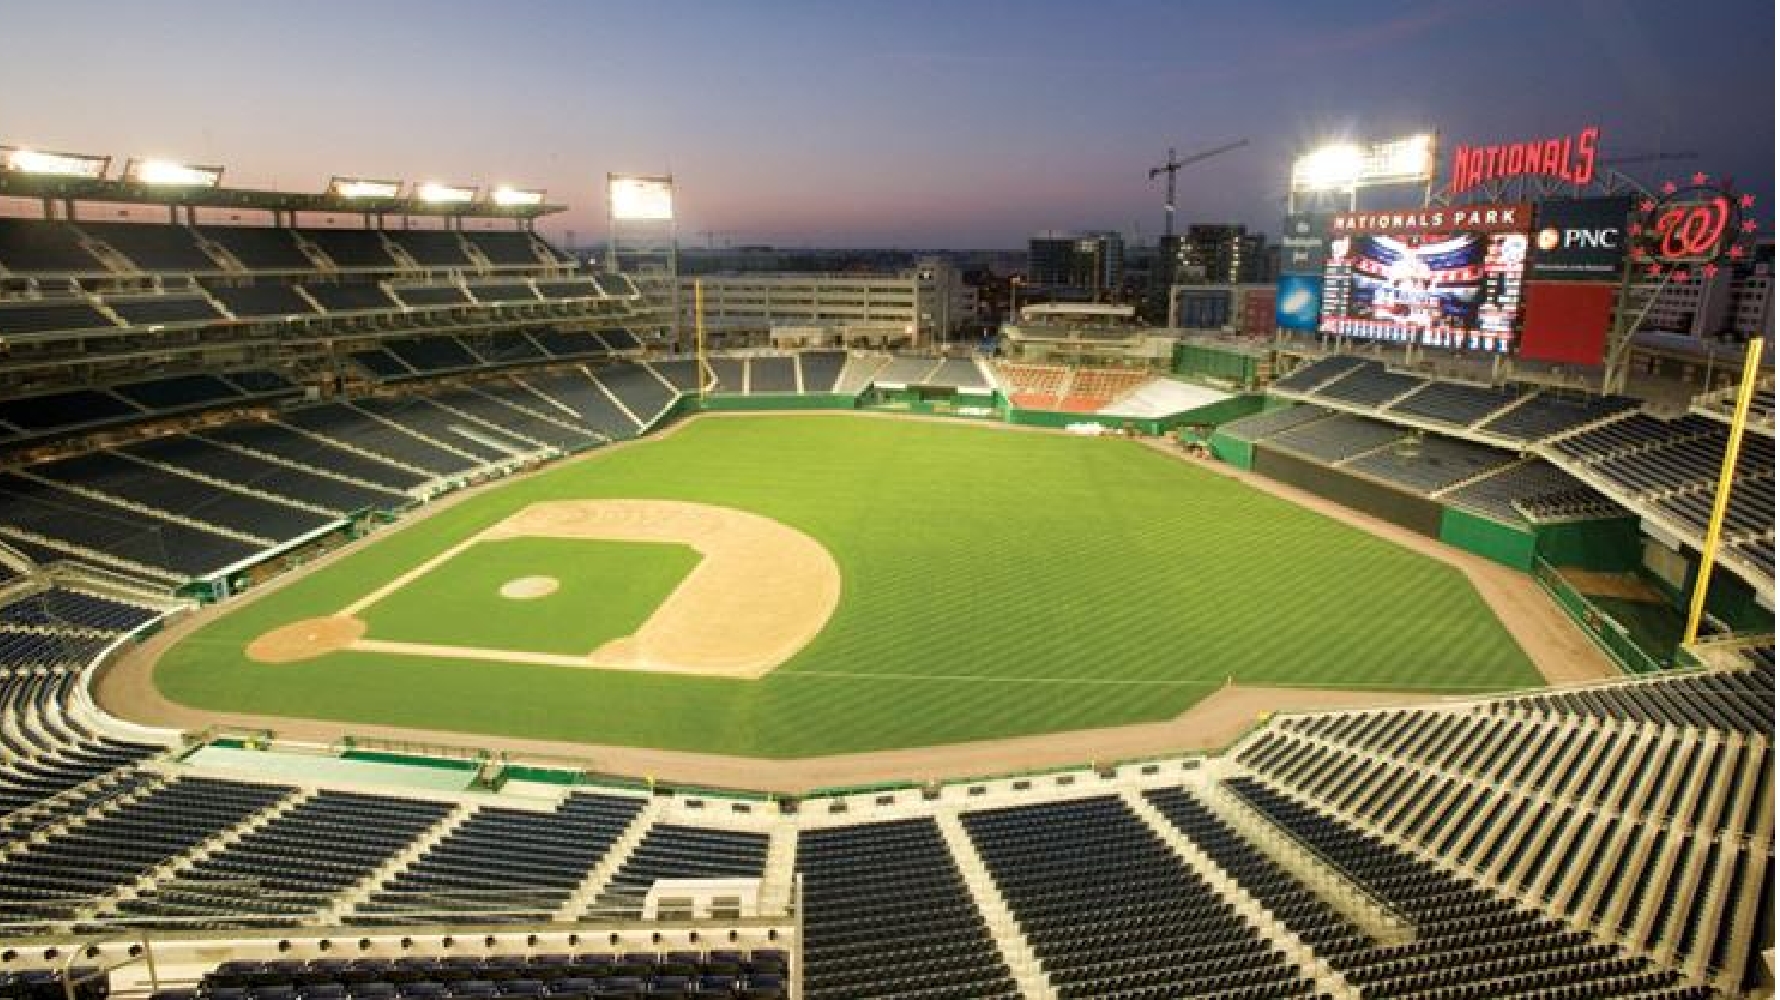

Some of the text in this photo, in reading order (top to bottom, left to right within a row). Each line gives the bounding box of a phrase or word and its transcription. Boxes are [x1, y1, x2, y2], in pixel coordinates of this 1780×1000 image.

[1450, 125, 1600, 195] NATIONALS
[1334, 208, 1517, 229] NATIONALS PARK
[1563, 228, 1619, 248] PNC
[1657, 195, 1730, 258] W
